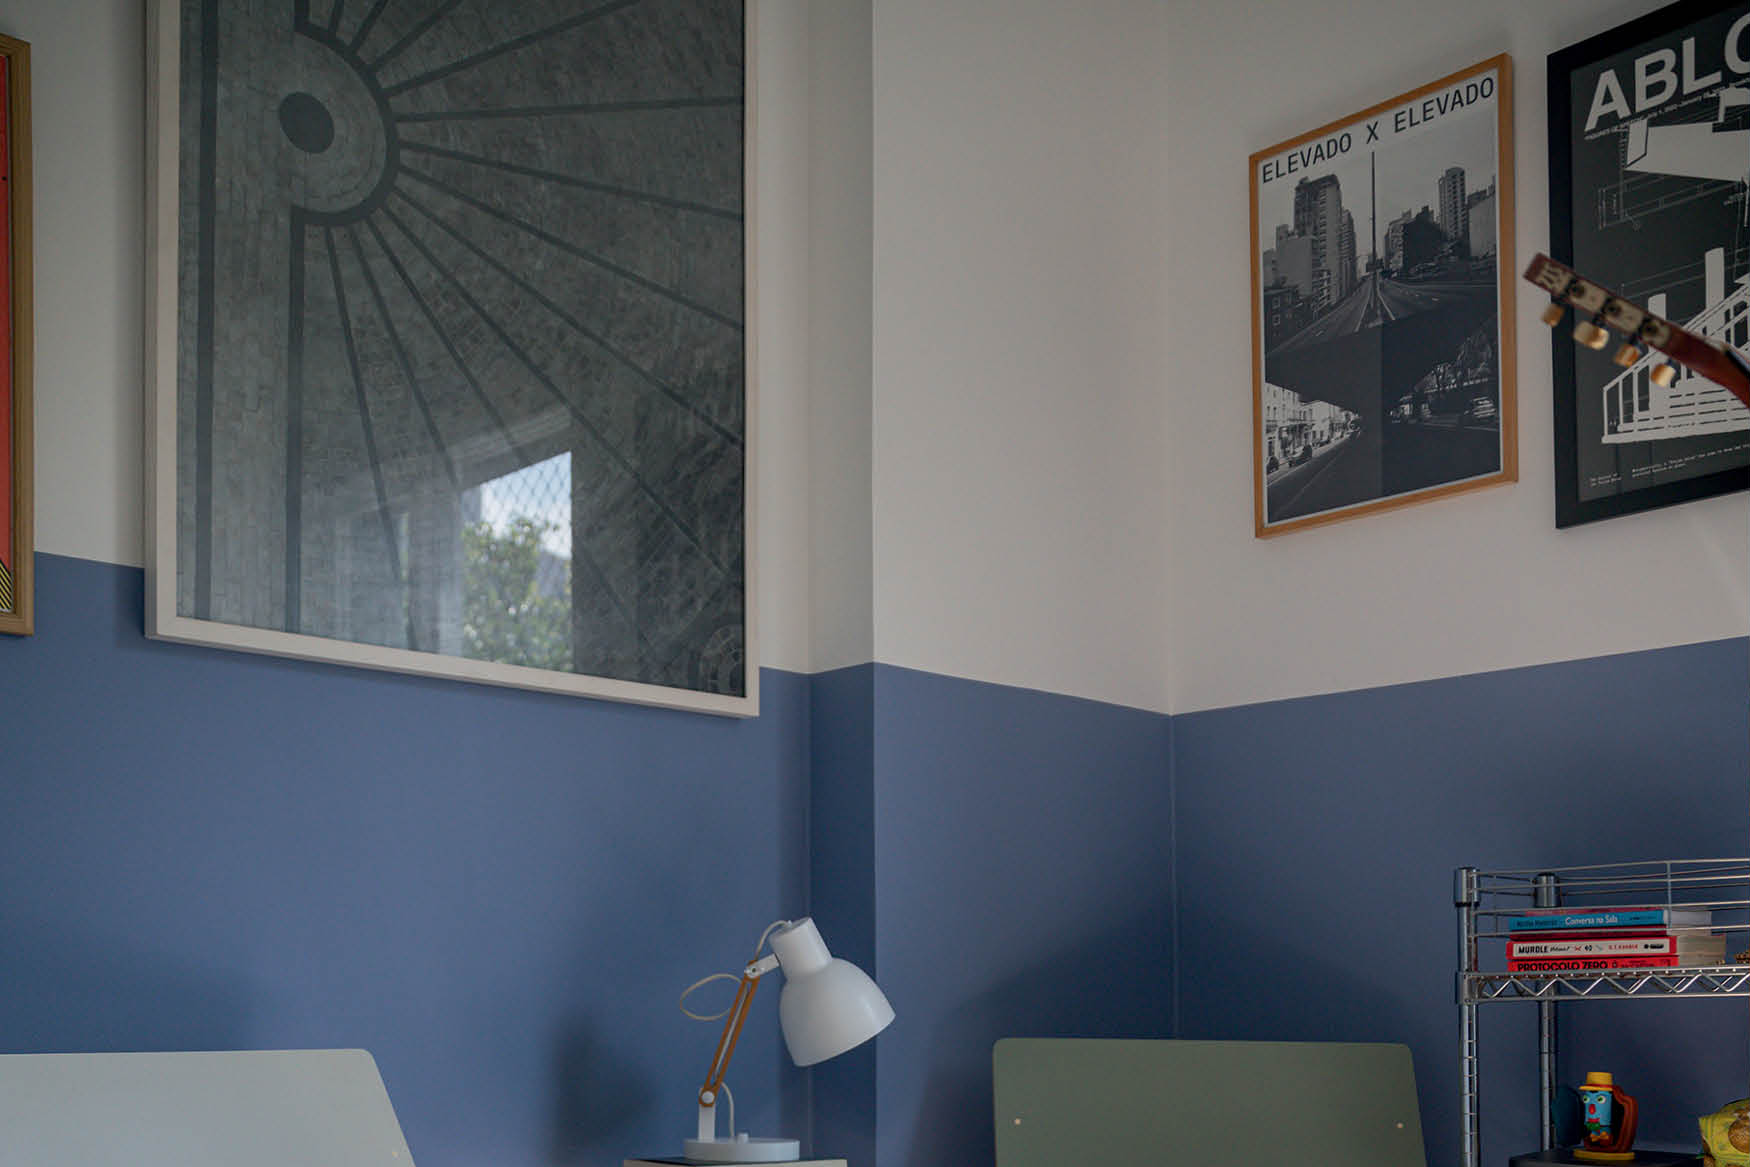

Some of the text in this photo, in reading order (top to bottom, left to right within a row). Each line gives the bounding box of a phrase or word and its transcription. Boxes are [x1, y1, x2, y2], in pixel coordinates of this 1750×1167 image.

[1262, 76, 1495, 184] ELEVADO X ELEVADO
[1518, 944, 1549, 954] MURDLE
[1517, 960, 1608, 972] PROTOCOLO ZERO
